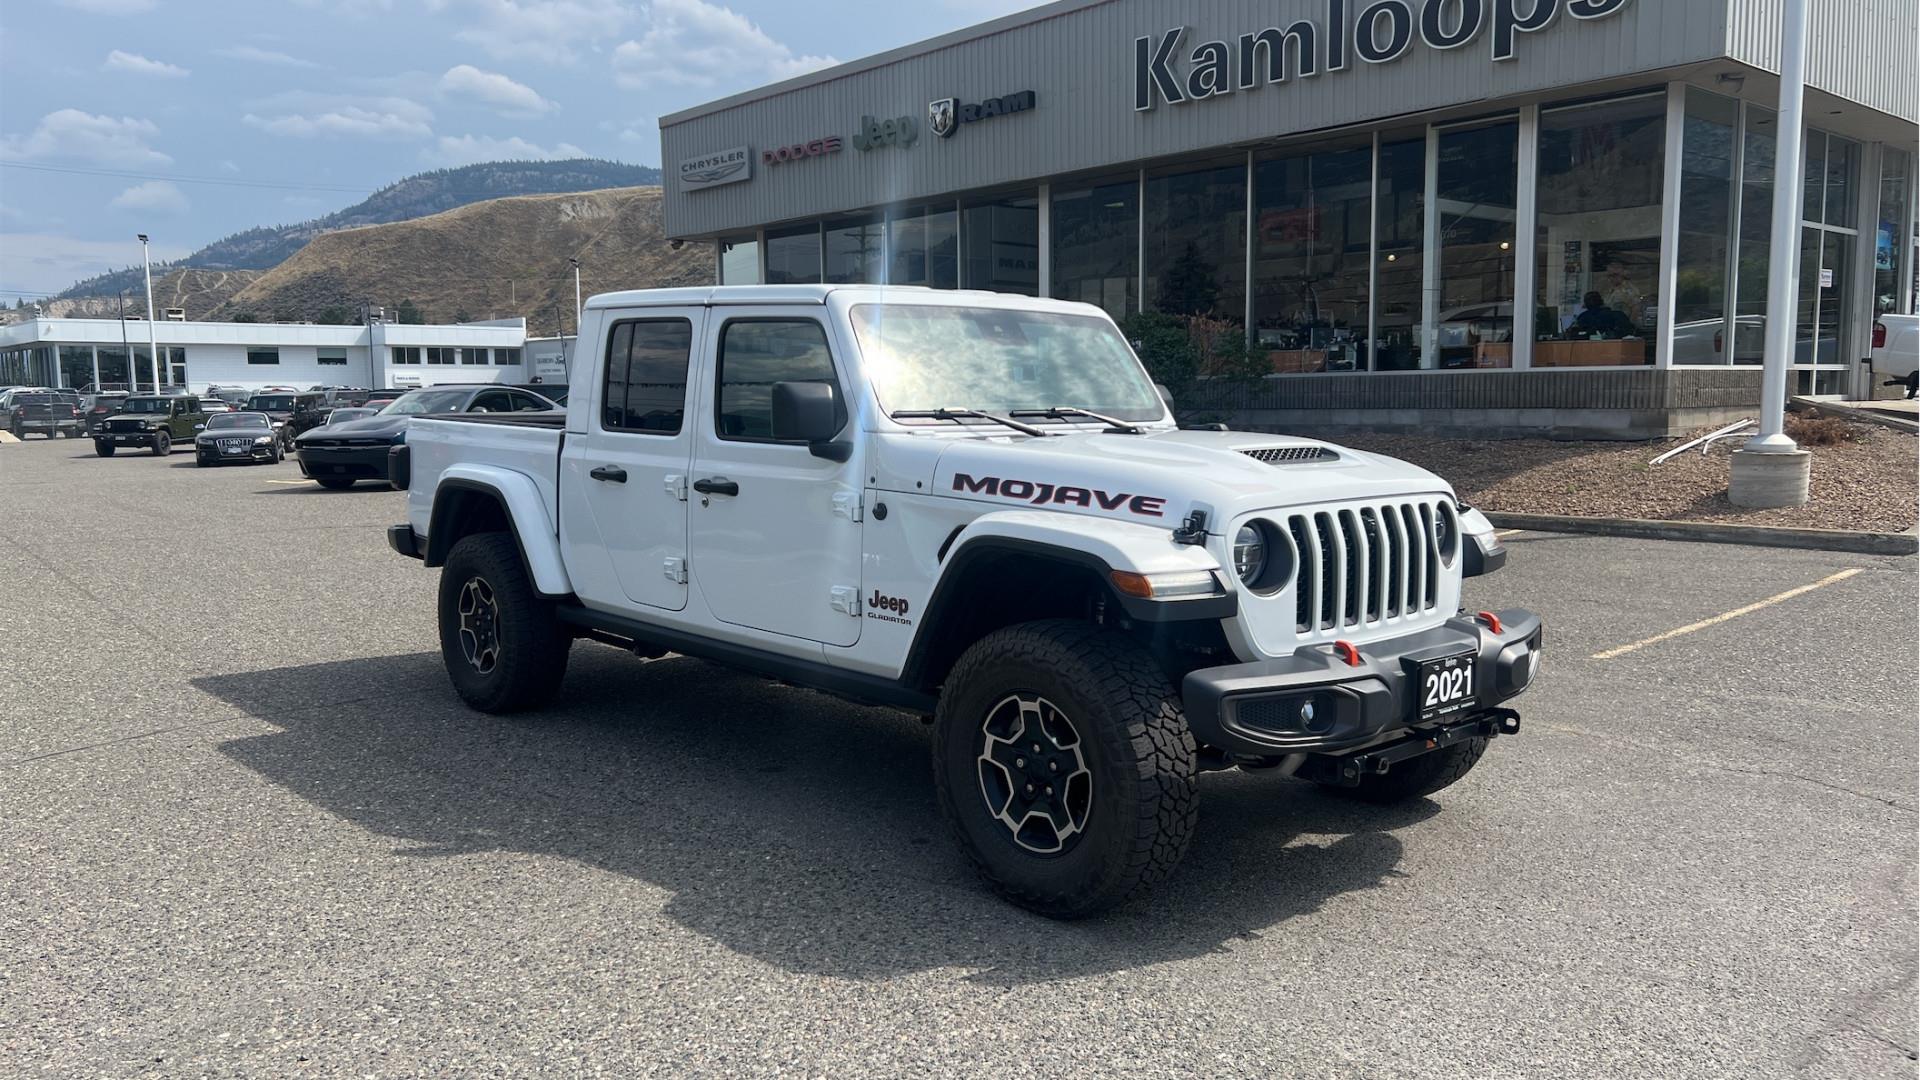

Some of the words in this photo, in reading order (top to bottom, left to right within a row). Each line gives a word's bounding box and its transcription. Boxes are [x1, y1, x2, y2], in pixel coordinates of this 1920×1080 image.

[958, 90, 1035, 123] RAM
[852, 115, 919, 151] Jeep
[681, 151, 744, 173] CHRYSLER
[762, 136, 842, 166] DODGE
[953, 473, 1166, 517] MOJAVE
[868, 589, 909, 616] Jeep
[867, 612, 912, 626] GLADIATOR
[1425, 664, 1472, 707] 2021
